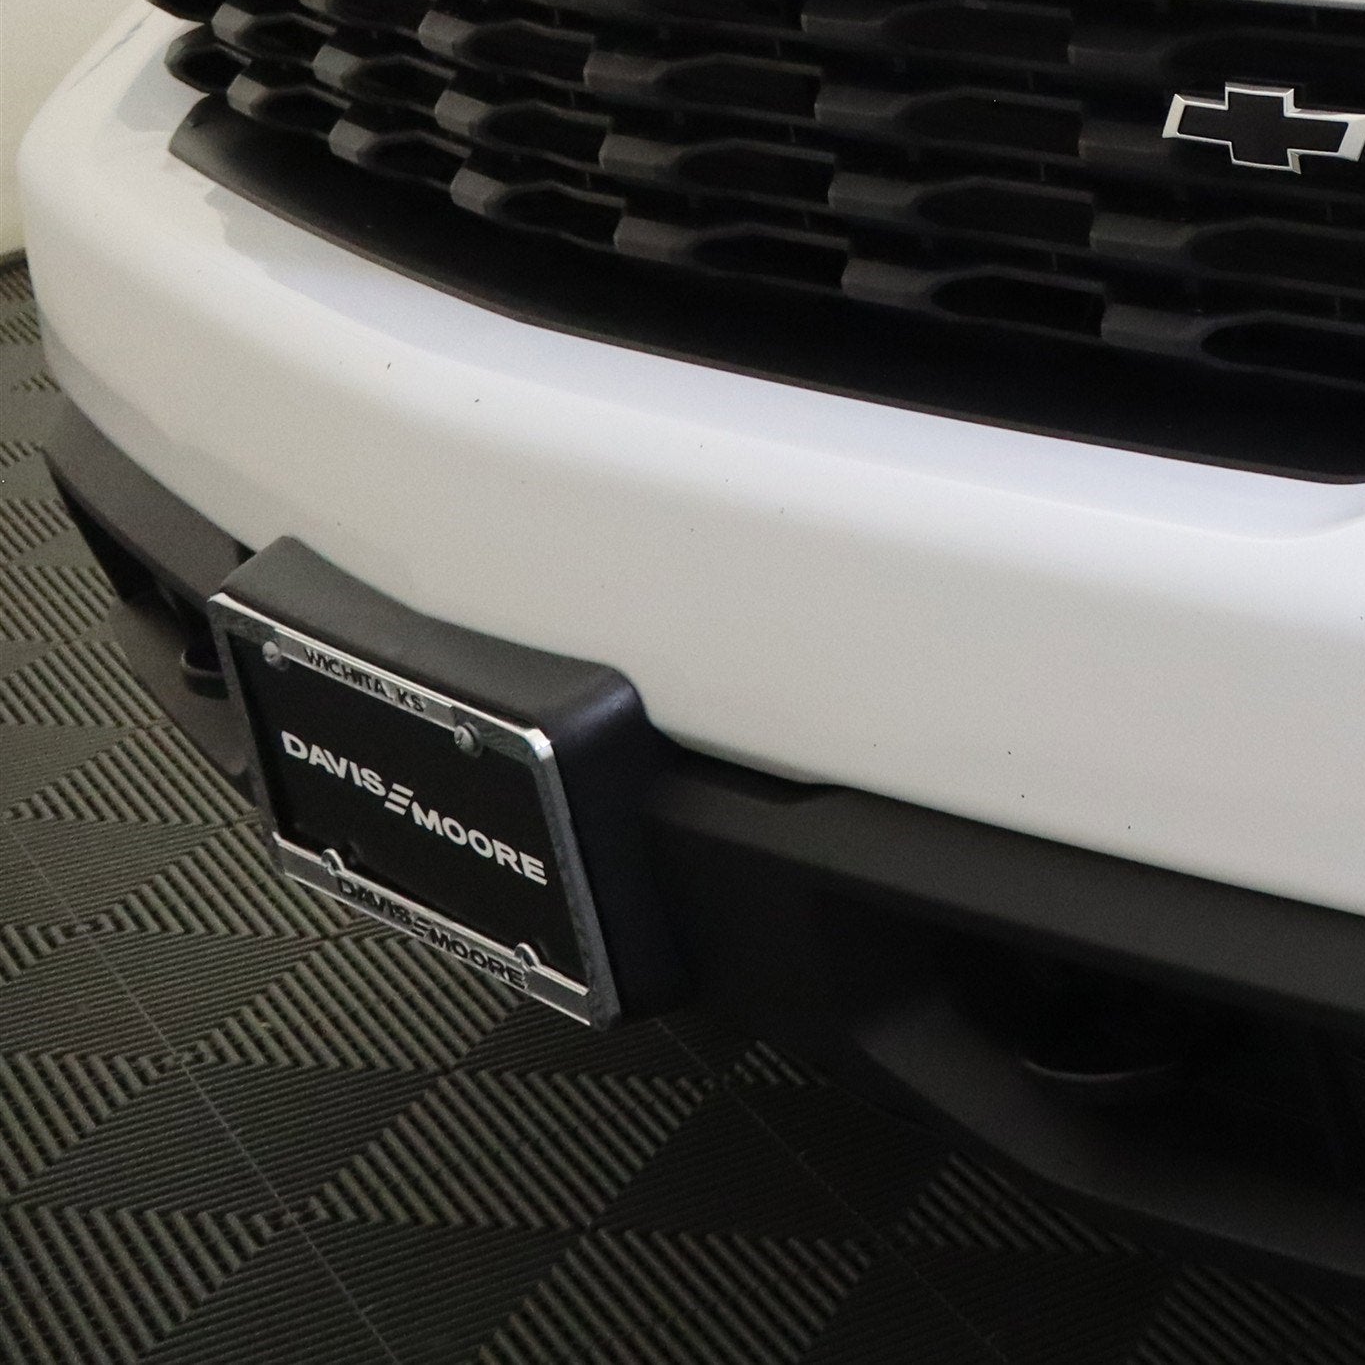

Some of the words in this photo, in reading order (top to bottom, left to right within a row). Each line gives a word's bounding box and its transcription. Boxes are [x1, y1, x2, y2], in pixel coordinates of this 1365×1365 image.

[396, 687, 425, 713] KS
[281, 730, 387, 798] DAVIS
[411, 801, 548, 886] MOORE
[338, 876, 413, 926] DAVIS
[429, 927, 528, 990] MOORE
